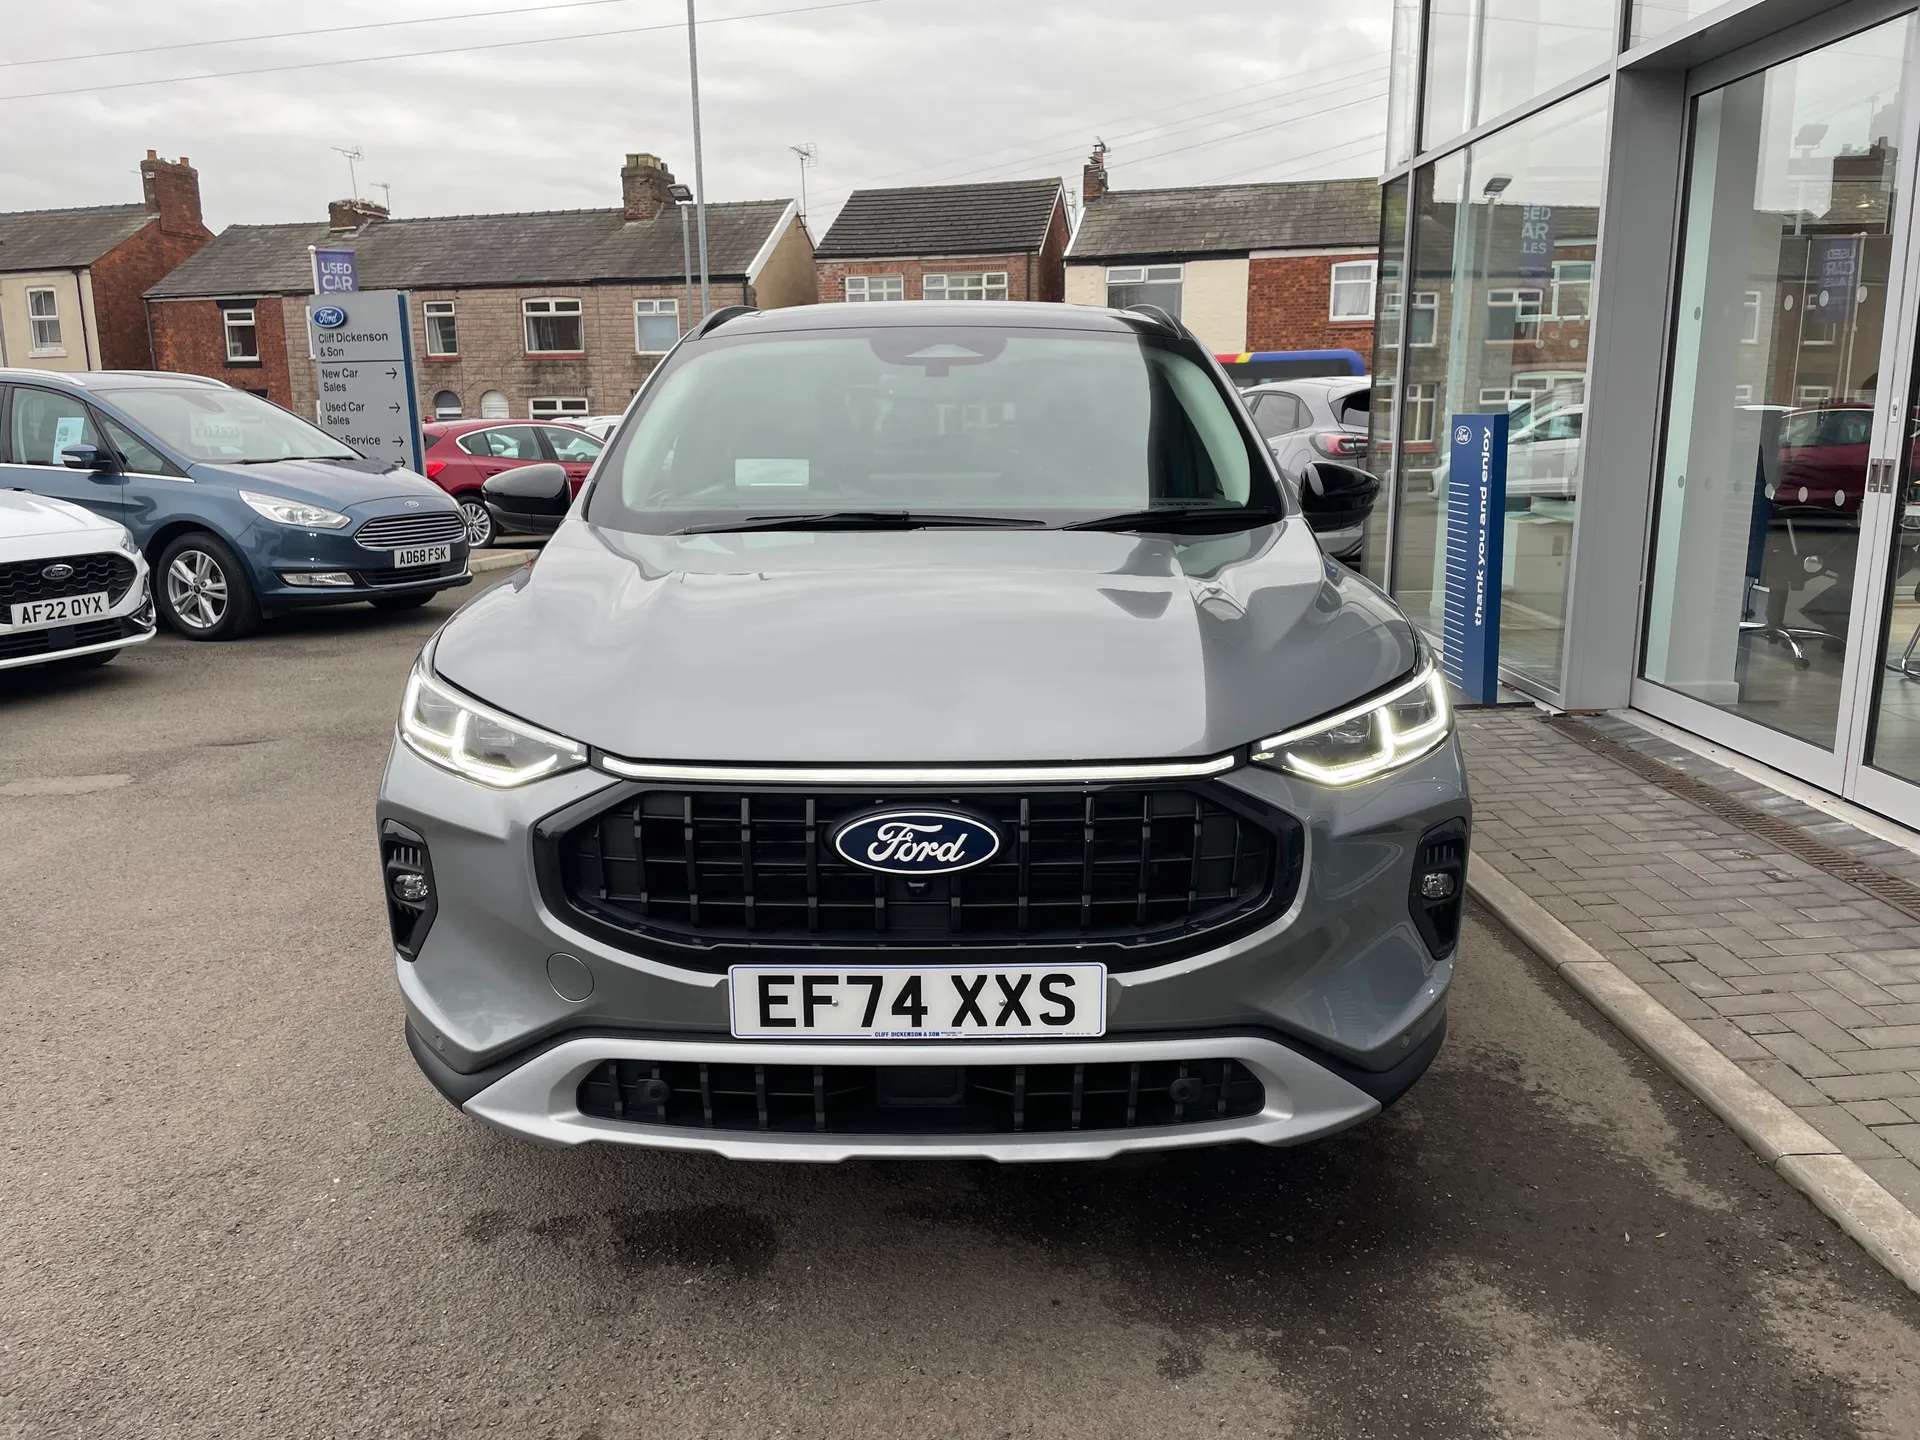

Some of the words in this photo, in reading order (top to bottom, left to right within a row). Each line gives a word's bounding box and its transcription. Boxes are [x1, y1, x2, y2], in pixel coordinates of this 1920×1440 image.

[321, 262, 352, 275] USED
[322, 275, 353, 291] CAR
[318, 309, 339, 324] Ford
[318, 332, 335, 344] Cliff
[336, 332, 389, 344] Dickenson
[320, 346, 326, 357] &
[327, 346, 344, 357] Son
[322, 368, 341, 379] New
[342, 367, 359, 378] Car
[323, 382, 347, 392] Sales
[325, 402, 347, 412] Used
[348, 401, 365, 412] Car
[327, 415, 350, 425] Sales
[345, 434, 381, 445] Service
[1481, 426, 1491, 483] enjoy
[1479, 486, 1488, 526] and
[1478, 529, 1486, 566] you
[400, 549, 426, 565] AD68
[428, 546, 447, 561] FSK
[1475, 570, 1484, 626] thank
[22, 602, 67, 624] AF22
[71, 596, 103, 617] OYX
[867, 822, 968, 862] Ford
[757, 974, 928, 1028] EF74
[951, 973, 1076, 1027] XXS
